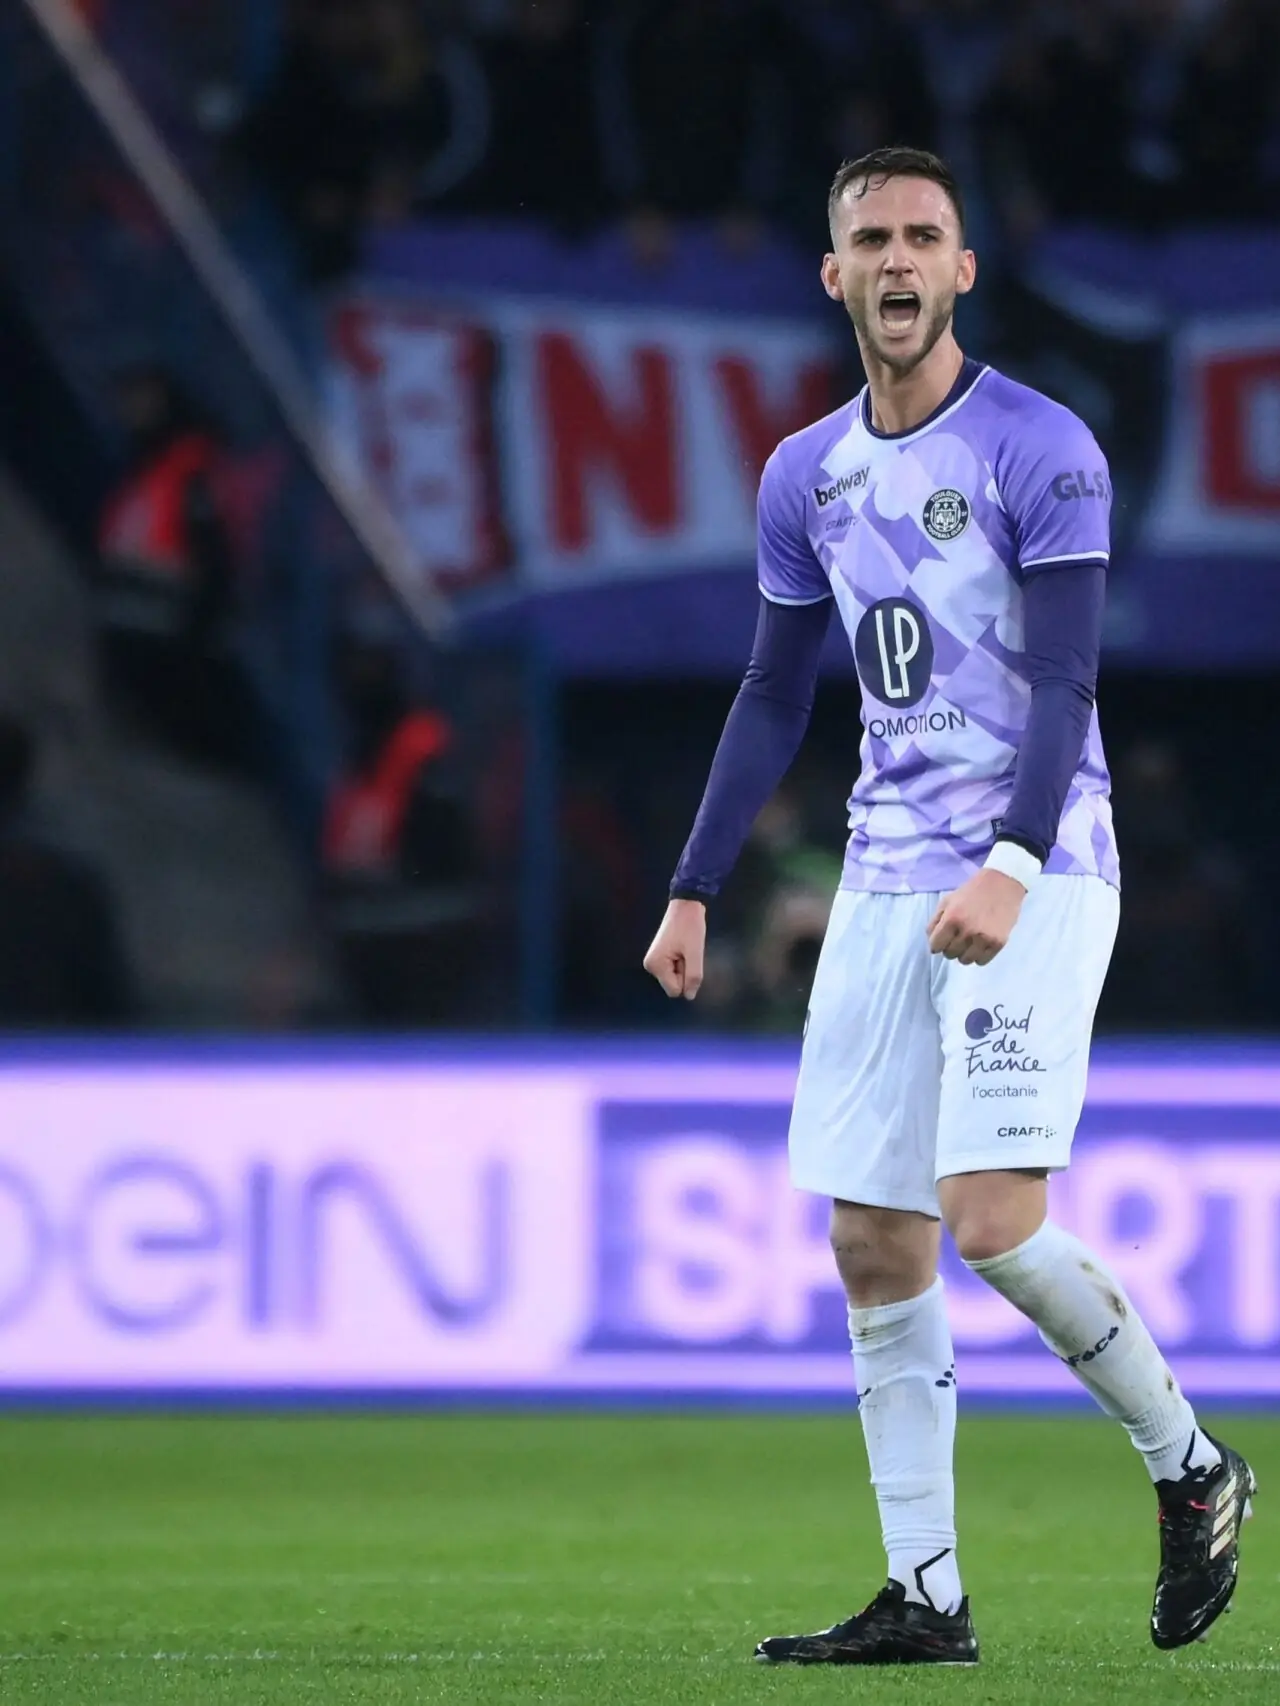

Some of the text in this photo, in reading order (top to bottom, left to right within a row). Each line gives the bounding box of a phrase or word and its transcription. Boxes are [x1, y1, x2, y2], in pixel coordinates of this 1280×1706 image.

[814, 466, 870, 507] betway
[930, 490, 962, 503] TOULOUSE
[926, 523, 951, 538] FOOTBALL
[875, 607, 920, 699] LP
[983, 1004, 1034, 1033] Sud
[992, 1033, 1025, 1054] de
[964, 1040, 1047, 1079] France
[972, 1085, 1038, 1099] l'occitanie
[997, 1127, 1043, 1138] CRAFT
